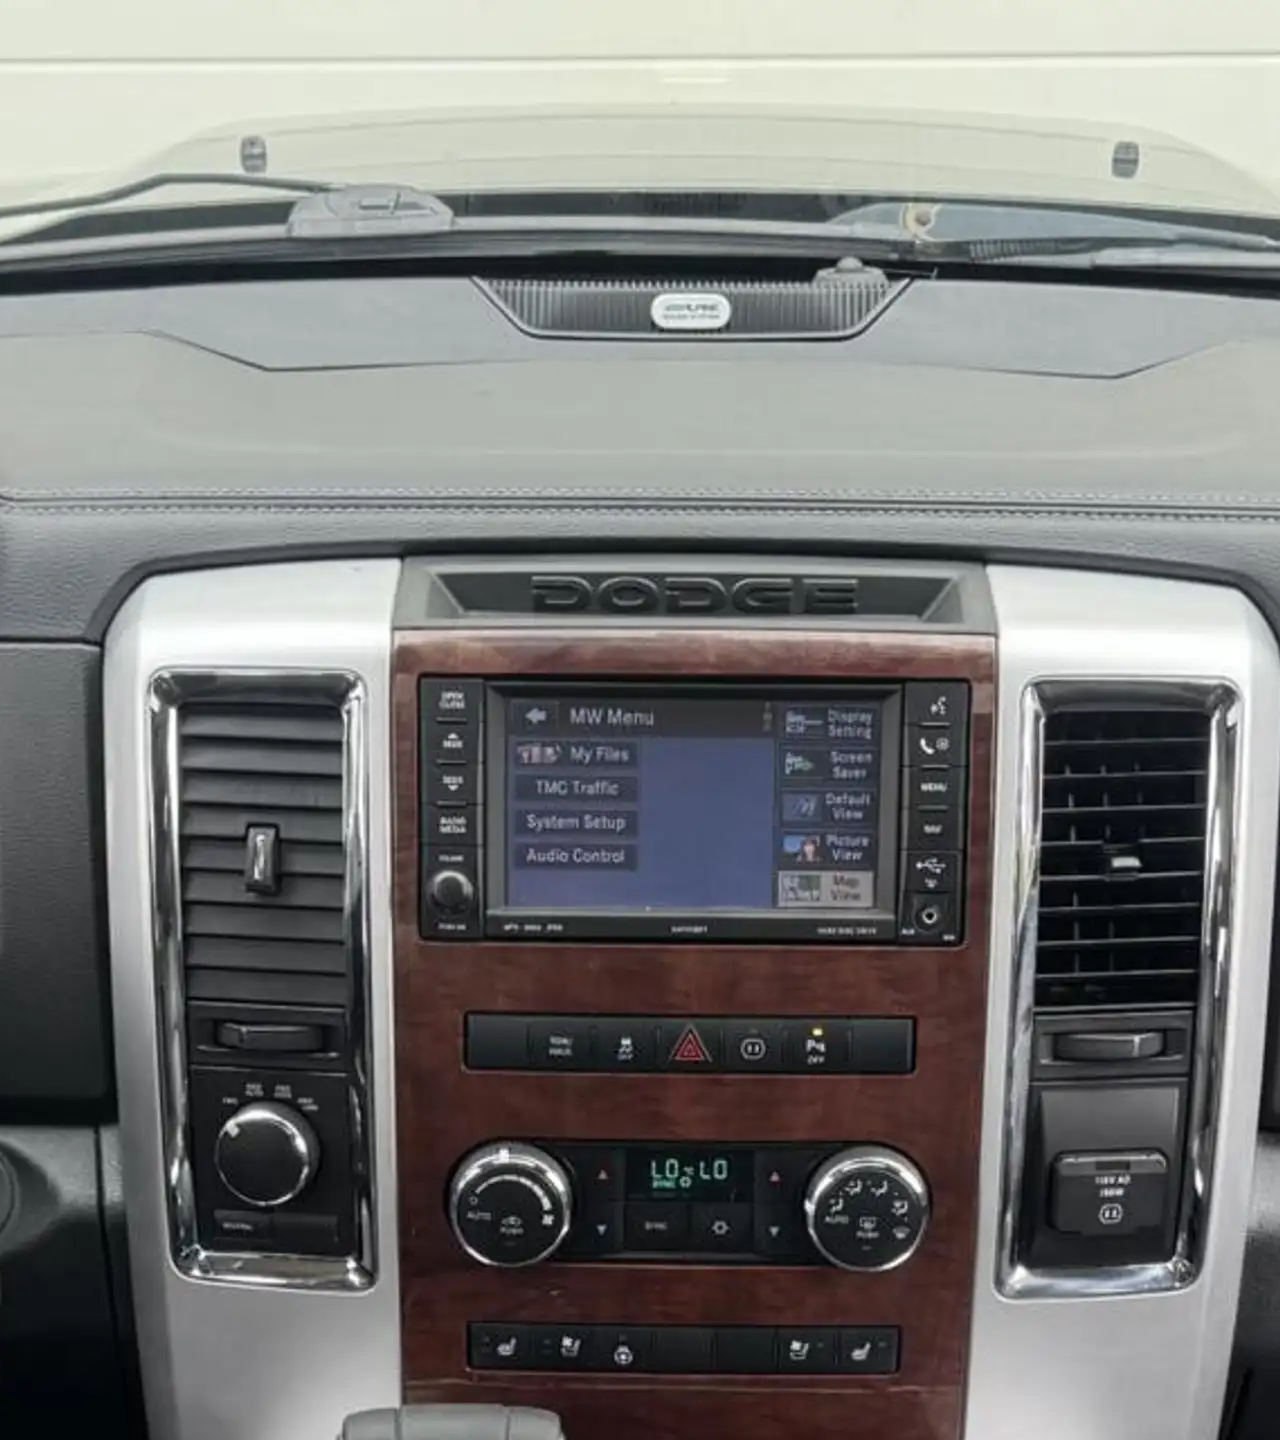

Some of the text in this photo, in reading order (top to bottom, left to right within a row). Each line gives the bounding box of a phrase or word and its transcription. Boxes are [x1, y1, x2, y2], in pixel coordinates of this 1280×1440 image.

[531, 575, 859, 615] DODGE
[570, 707, 654, 726] MW Menu
[827, 708, 873, 725] Display
[827, 725, 872, 739] Setting
[571, 746, 629, 765] My Files
[830, 751, 872, 764] Screen
[832, 765, 867, 779] Saver
[536, 779, 620, 796] TMC Traffic
[825, 792, 871, 805] Default
[832, 807, 863, 820] View
[526, 813, 627, 833] System Setup
[825, 834, 870, 847] Picture
[526, 847, 625, 863] Audio Control
[832, 848, 863, 861] View
[651, 1158, 679, 1179] LO
[699, 1159, 728, 1180] LO
